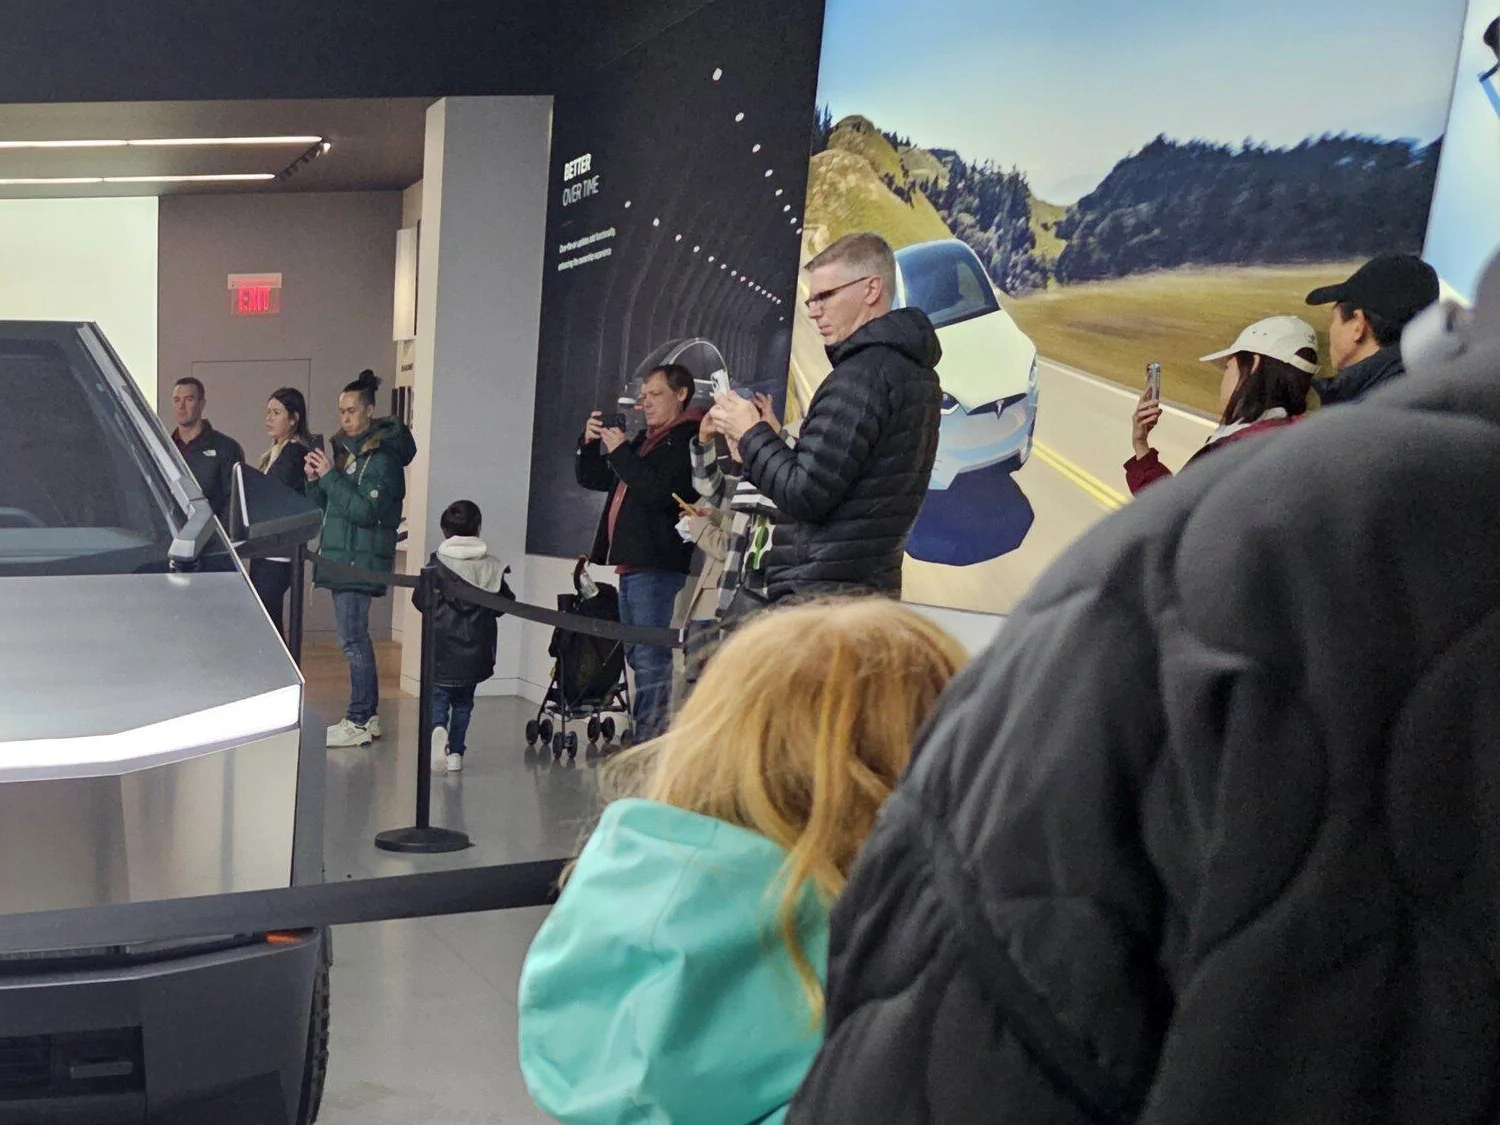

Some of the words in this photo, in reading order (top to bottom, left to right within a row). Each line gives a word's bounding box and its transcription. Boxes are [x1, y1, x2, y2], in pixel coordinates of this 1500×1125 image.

[564, 153, 592, 181] BETTER
[562, 182, 582, 206] OVER
[583, 174, 600, 198] TIME
[238, 286, 271, 314] EXIT
